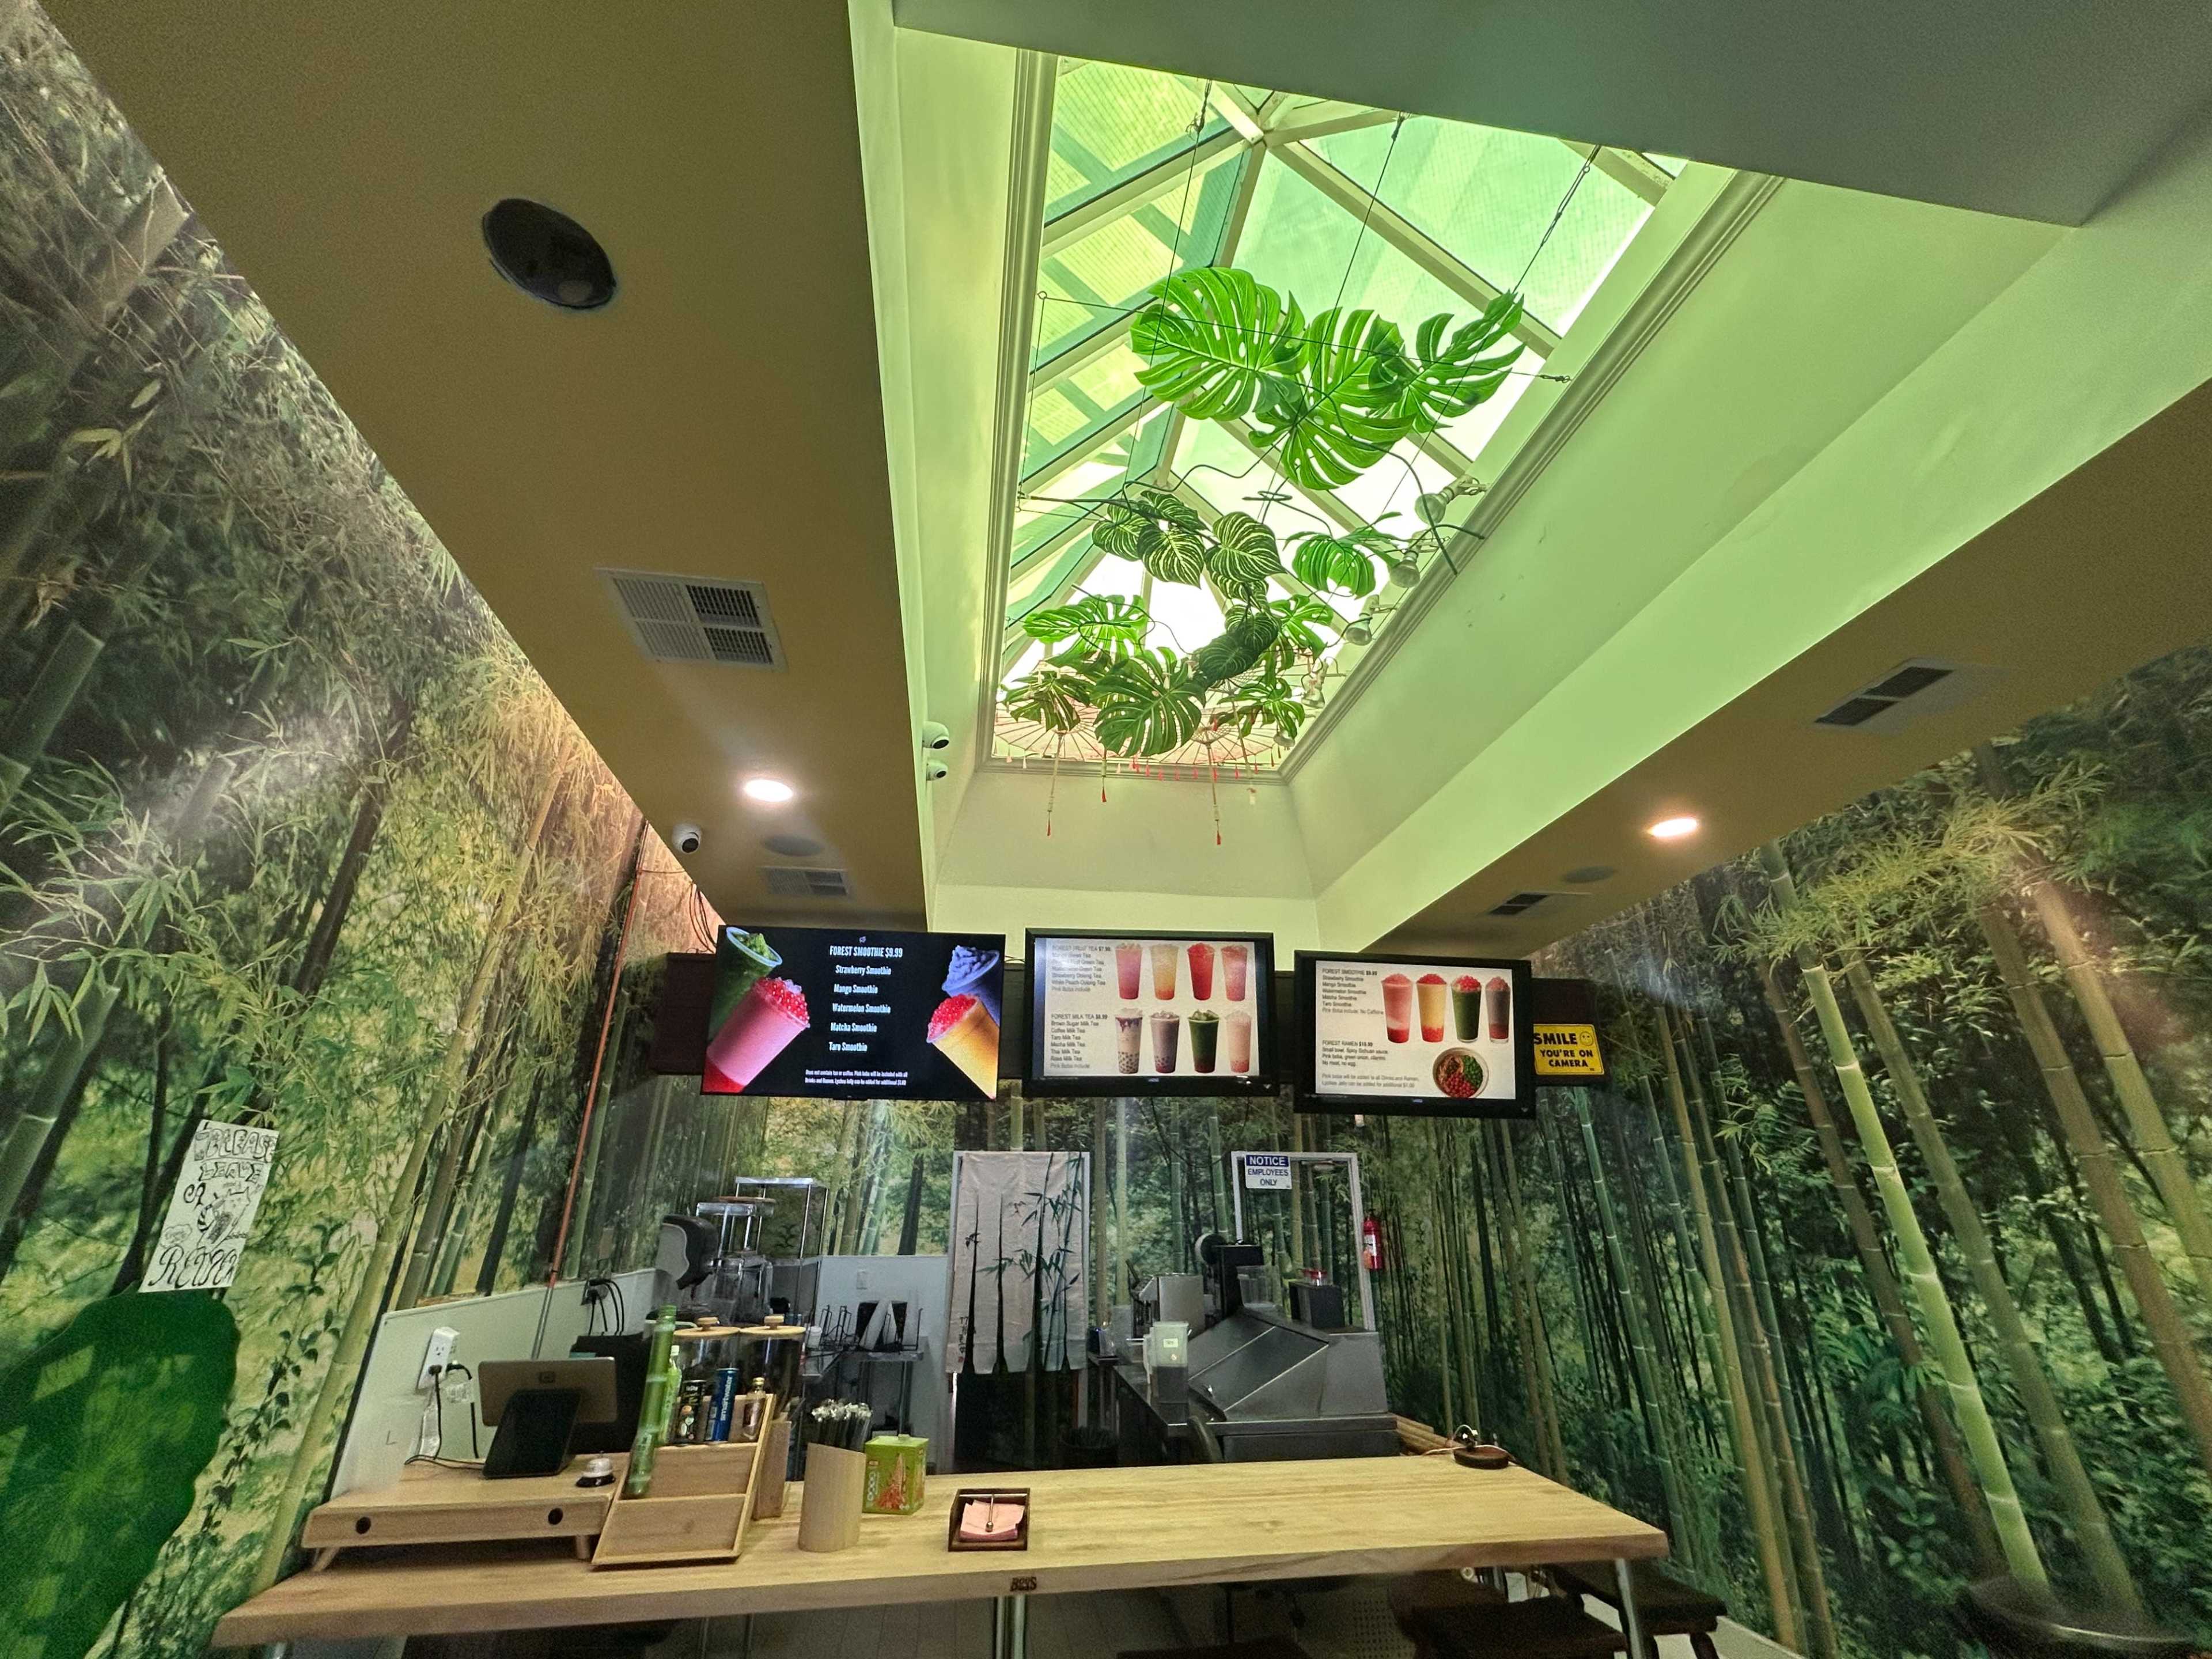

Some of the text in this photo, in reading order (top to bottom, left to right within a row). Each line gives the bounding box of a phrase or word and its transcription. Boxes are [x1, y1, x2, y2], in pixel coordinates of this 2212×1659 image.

[830, 945, 903, 957] FOREST SMOOTHIE $9.99
[835, 964, 891, 976] Strawberry Smoothie
[834, 983, 878, 995] Mango Smoothie
[832, 1003, 891, 1013] Watermelon Smoothie
[830, 1022, 877, 1032] Matcha Smoothie
[1533, 1032, 1577, 1045] SMILE
[828, 1041, 868, 1051] Taro Smoothie
[1540, 1050, 1575, 1058] YOU'RE
[1548, 1059, 1588, 1067] CAMERA
[194, 1127, 278, 1162] PLEASE
[1249, 1156, 1286, 1166] NOTICE
[720, 1376, 733, 1421] smartwater
